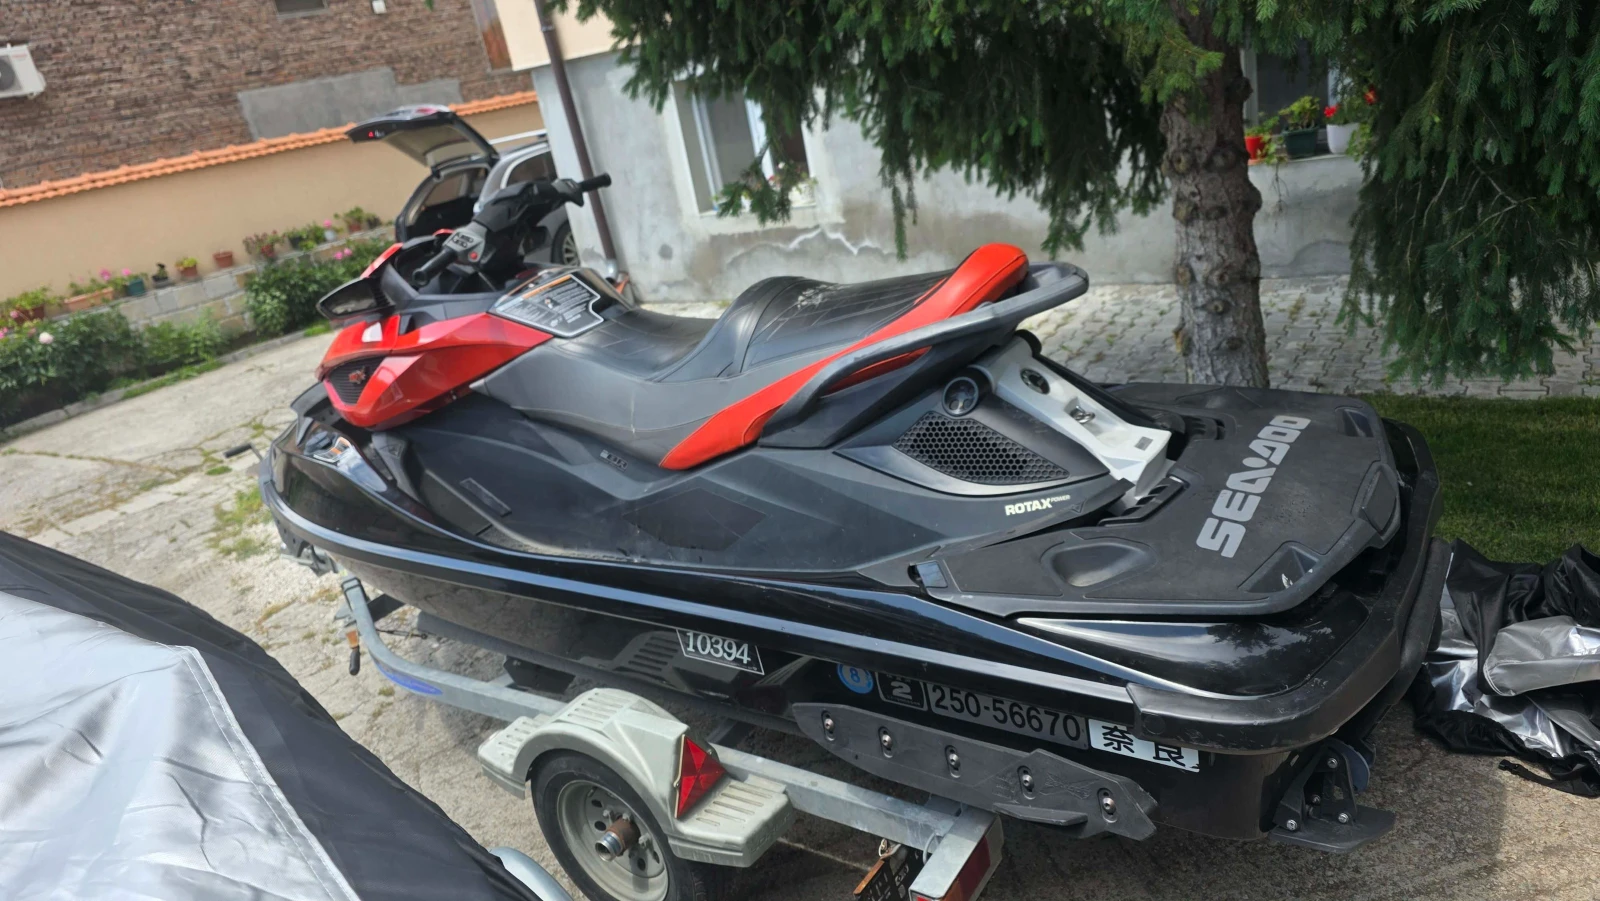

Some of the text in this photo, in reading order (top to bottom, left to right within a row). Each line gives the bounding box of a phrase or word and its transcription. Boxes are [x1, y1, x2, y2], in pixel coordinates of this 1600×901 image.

[1004, 497, 1053, 516] ROTAX
[686, 630, 752, 665] 10394
[849, 667, 861, 683] 8
[890, 680, 913, 700] 2
[931, 684, 1082, 742] 250-56670
